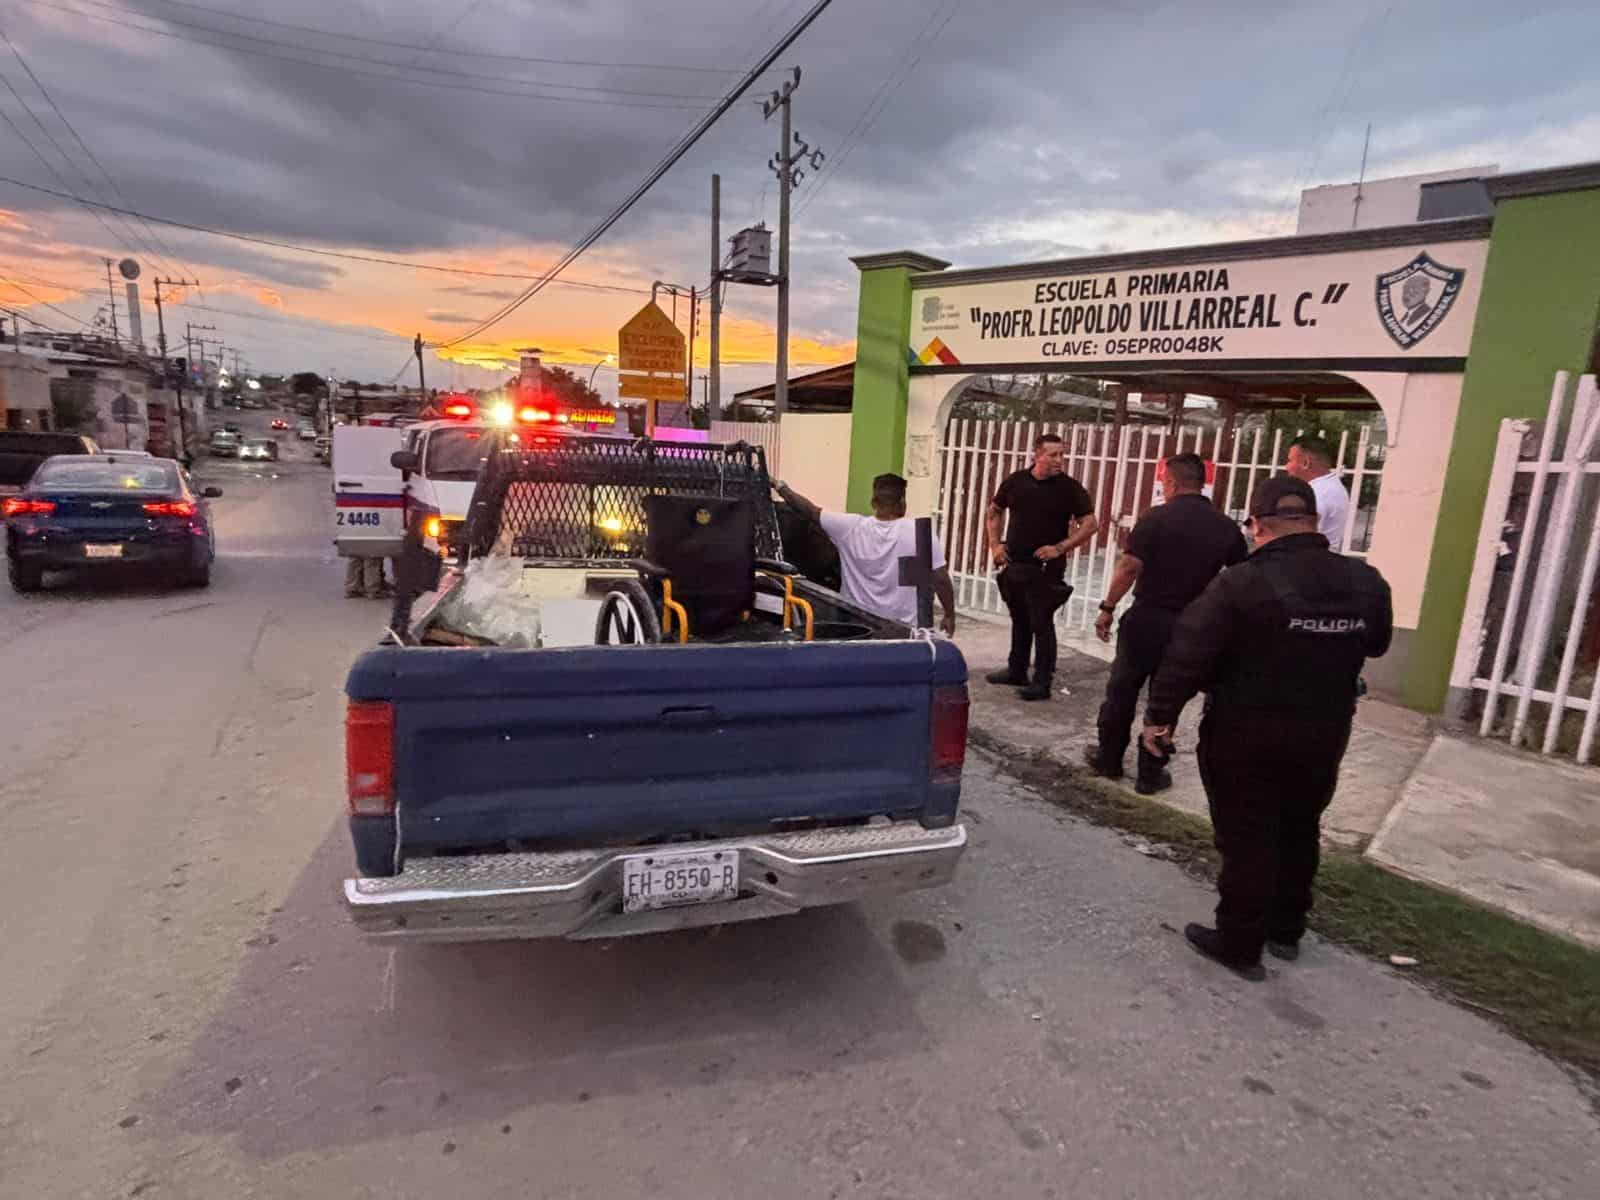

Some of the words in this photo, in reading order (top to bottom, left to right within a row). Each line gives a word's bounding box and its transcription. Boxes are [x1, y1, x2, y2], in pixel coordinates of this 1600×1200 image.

[1035, 277, 1117, 304] ESCUELA
[1127, 268, 1229, 297] PRIMARIA
[1039, 302, 1132, 337] LEOPOLDO
[1139, 293, 1282, 332] VILLARREAL
[1042, 340, 1098, 356] CLAVE:
[1288, 617, 1367, 632] POLICIA
